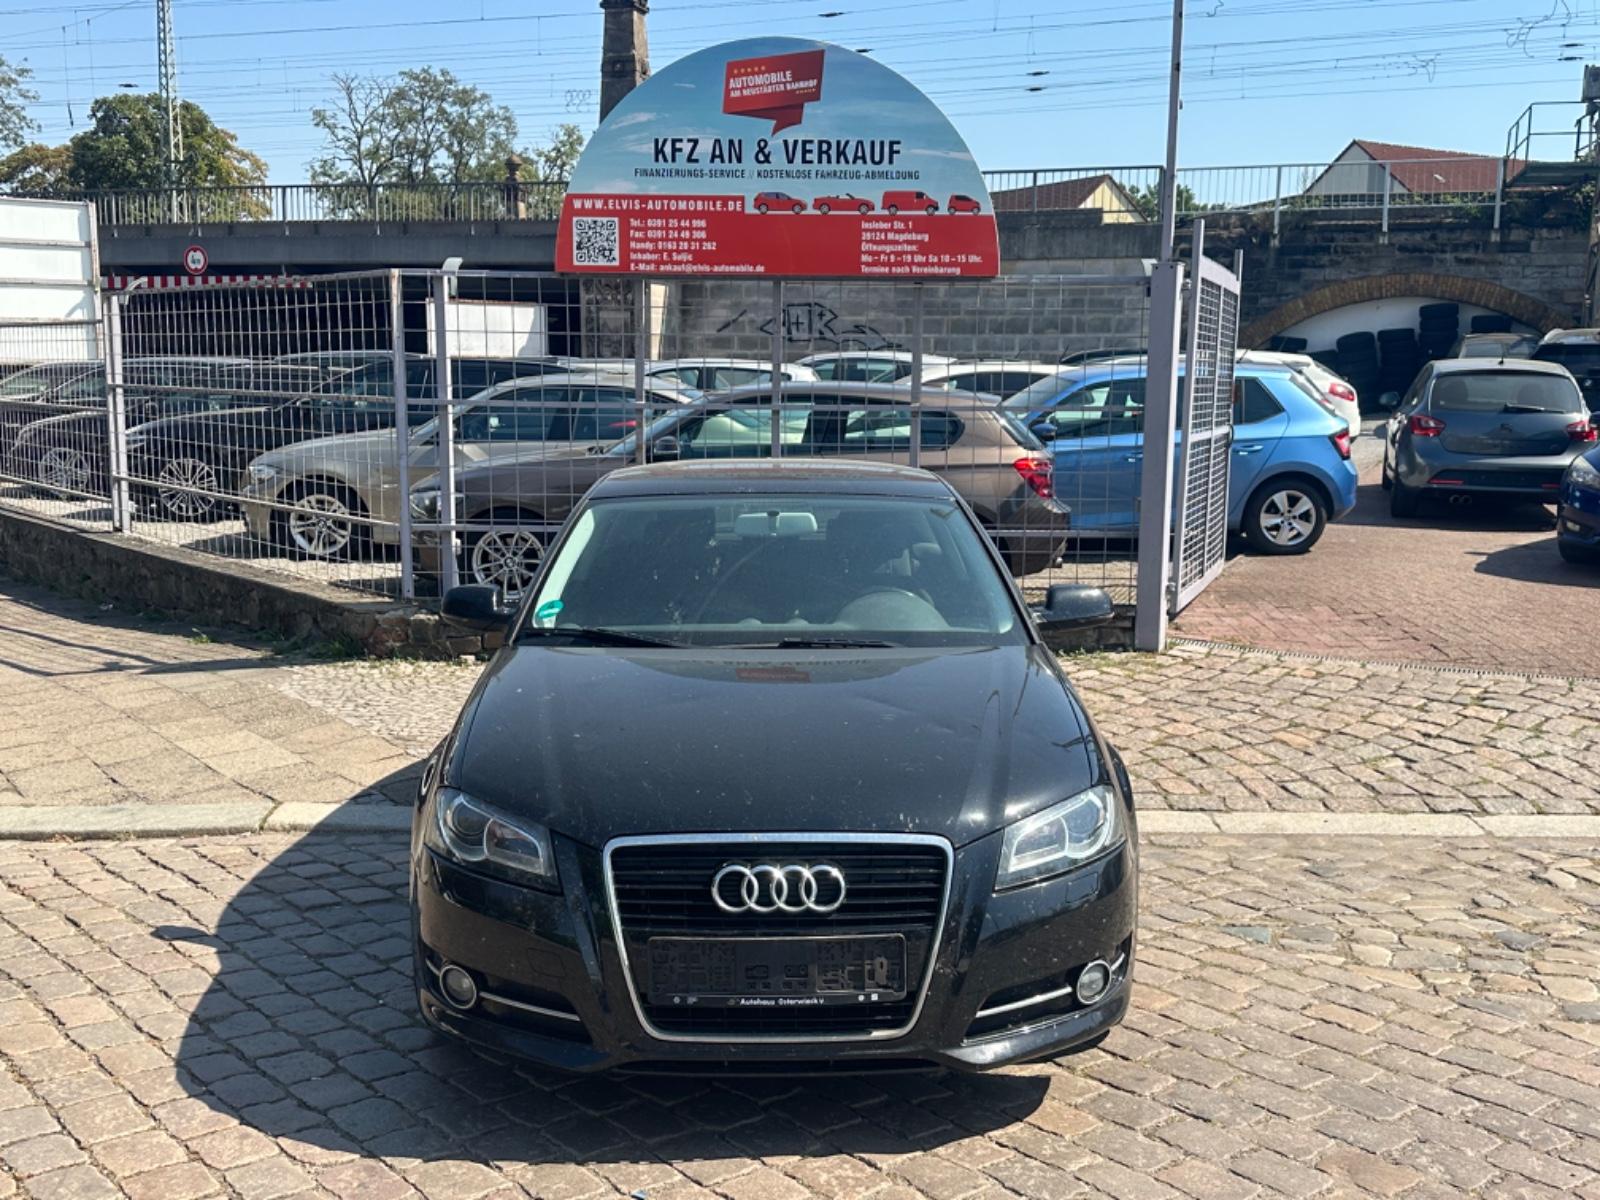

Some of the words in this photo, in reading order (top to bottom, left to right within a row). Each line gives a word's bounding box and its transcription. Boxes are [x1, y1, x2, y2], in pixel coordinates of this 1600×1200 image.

[729, 70, 793, 89] AUTOMOBILE
[730, 88, 741, 98] AM
[786, 79, 818, 90] BAHNHOF
[653, 138, 699, 164] KFZ
[709, 138, 743, 164] AN
[754, 138, 772, 164] &
[783, 139, 901, 165] VERKAUF
[634, 168, 746, 179] FINANZIERUNGS-SERVICE
[757, 169, 812, 179] KOSTENLOSE
[815, 170, 920, 181] FAHRZEUG-ABMELDUNG
[572, 198, 743, 212] WWW.ELVIS-AUTOMOBILE.DE
[647, 219, 666, 228] 0391
[680, 219, 690, 228] 44
[861, 232, 885, 240] 39124
[887, 232, 929, 242] Magdeburg
[630, 241, 656, 251] Handy:
[630, 252, 661, 261] Inhaber:
[861, 254, 872, 262] Mo
[880, 254, 889, 262] Fr
[630, 263, 658, 271] E-Mail:
[861, 265, 889, 273] Termine
[891, 265, 910, 273] nach
[911, 265, 961, 275] Vereinbarung
[740, 998, 776, 1006] Autohaus
